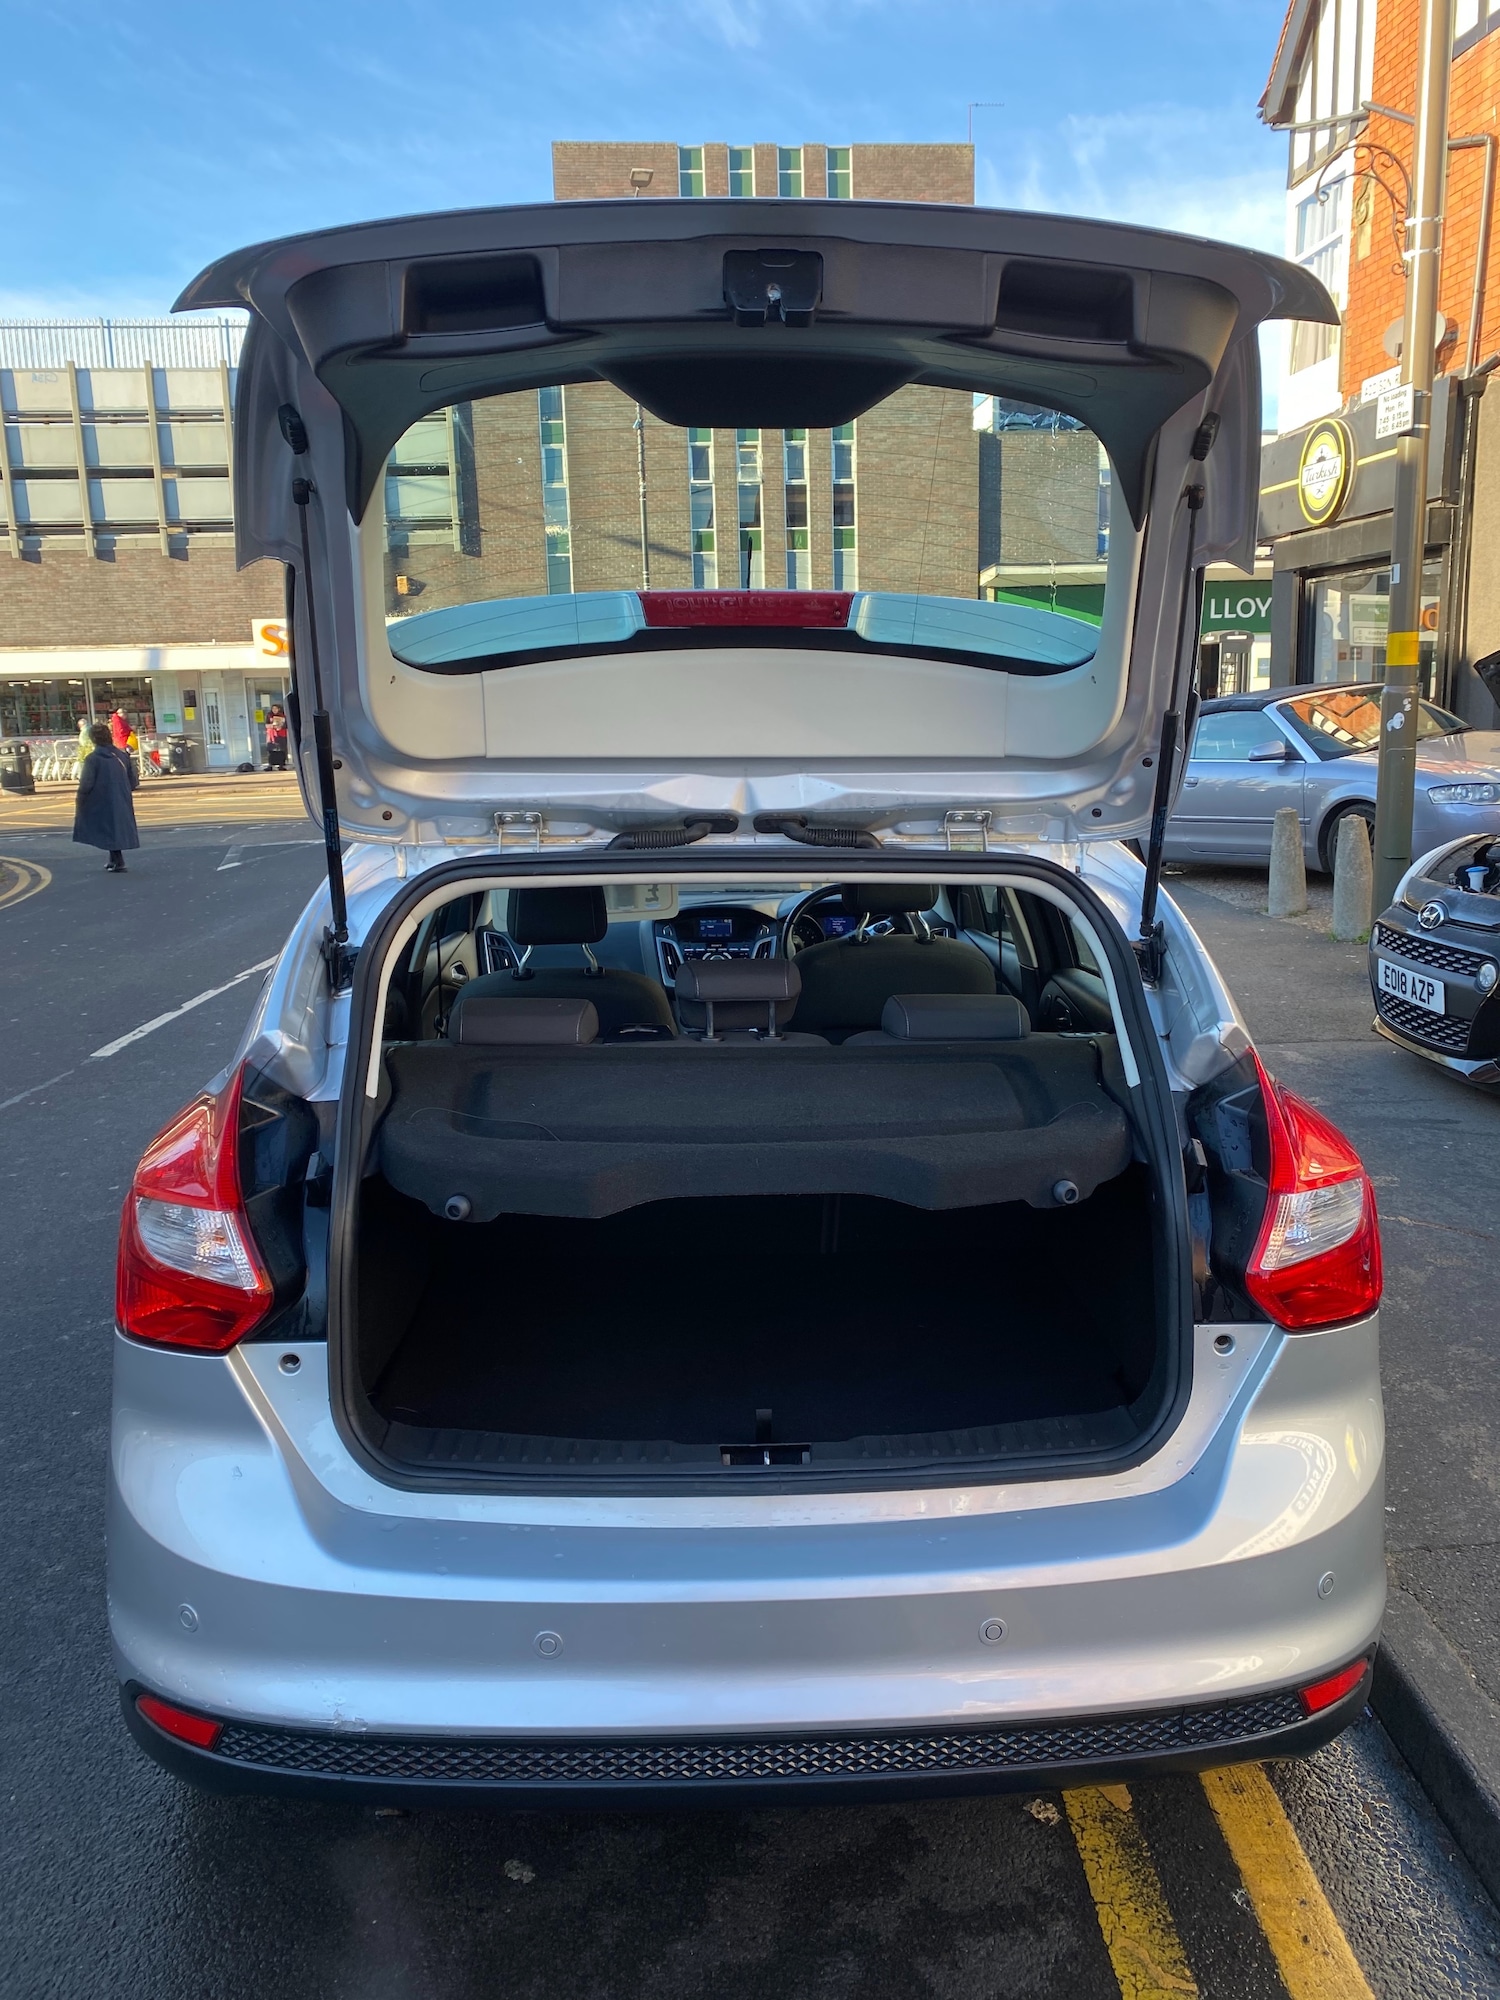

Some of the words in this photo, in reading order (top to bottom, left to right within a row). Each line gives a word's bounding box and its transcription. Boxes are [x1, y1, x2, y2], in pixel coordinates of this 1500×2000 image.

[1304, 460, 1338, 484] Turkish
[1210, 596, 1272, 619] LLOY
[1384, 964, 1407, 995] EO18
[1410, 976, 1435, 1005] AZP
